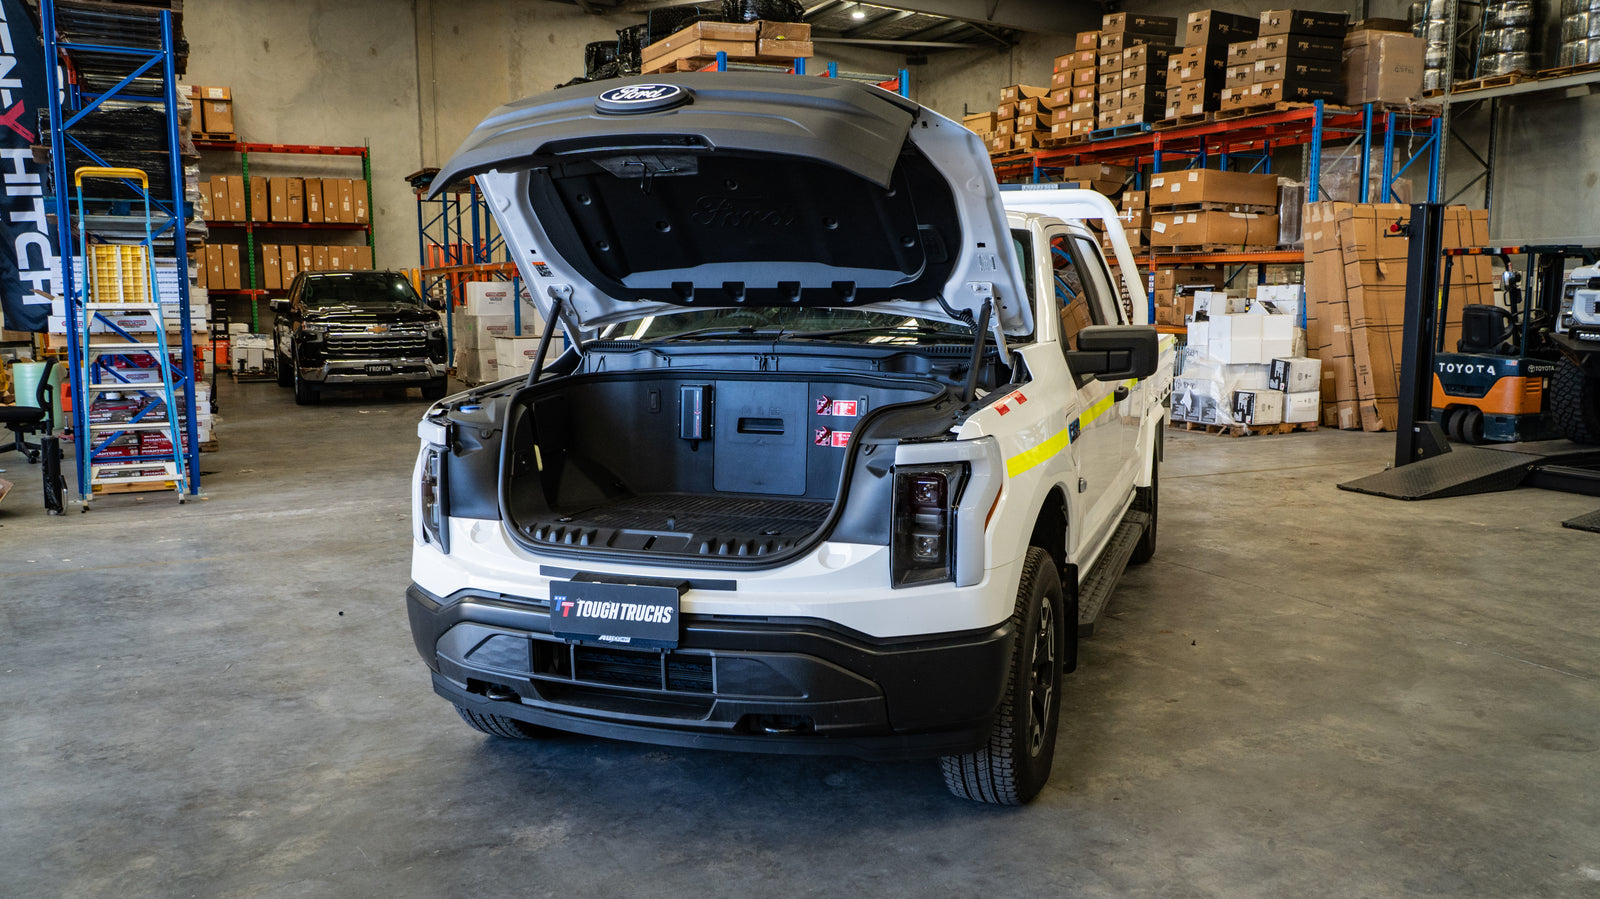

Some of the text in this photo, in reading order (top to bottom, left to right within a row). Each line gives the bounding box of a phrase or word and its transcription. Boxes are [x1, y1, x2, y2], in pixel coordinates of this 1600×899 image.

[611, 84, 667, 100] Ford
[0, 148, 53, 305] HITCH
[1439, 362, 1496, 376] TOYOTA
[576, 598, 620, 620] TOUGH
